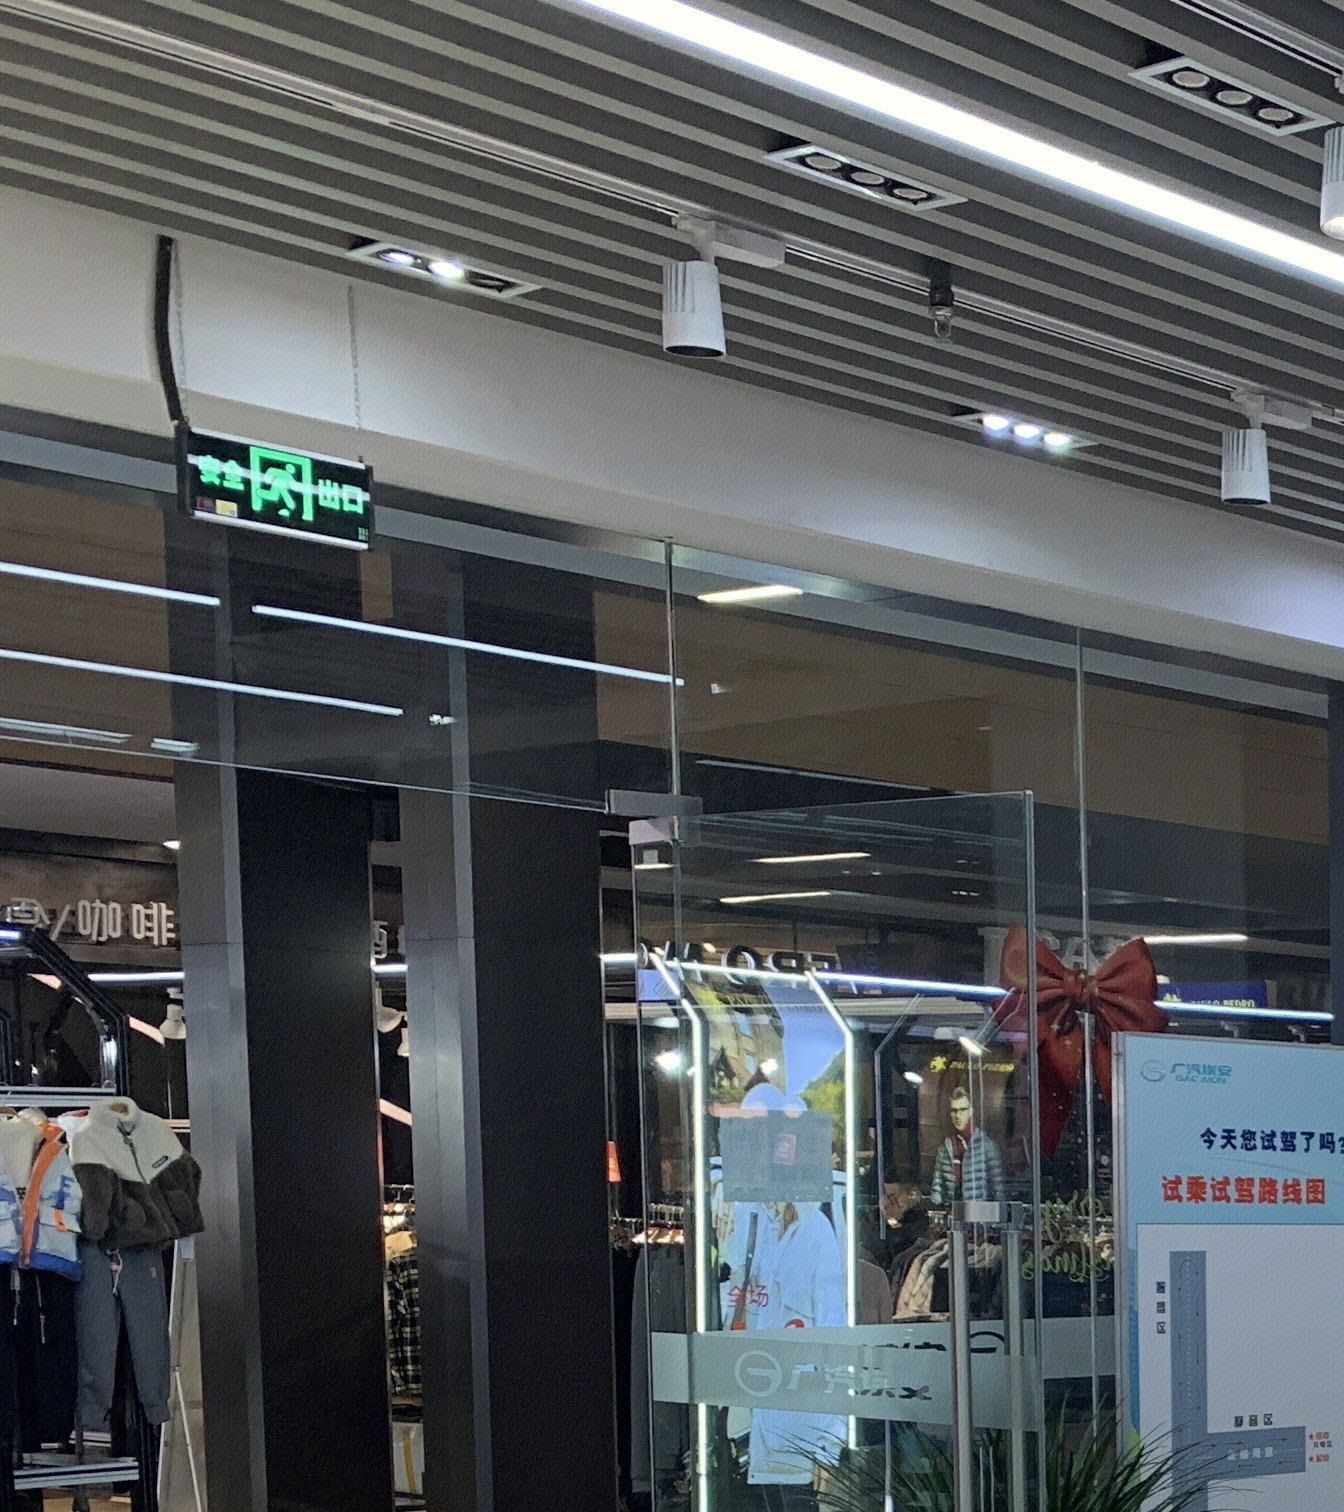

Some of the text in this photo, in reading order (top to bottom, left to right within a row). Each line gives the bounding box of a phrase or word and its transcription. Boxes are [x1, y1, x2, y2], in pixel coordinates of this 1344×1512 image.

[198, 455, 364, 514] 安全 出口
[1162, 1175, 1326, 1205] 试乘试驾路线图
[727, 1284, 768, 1308] 全场
